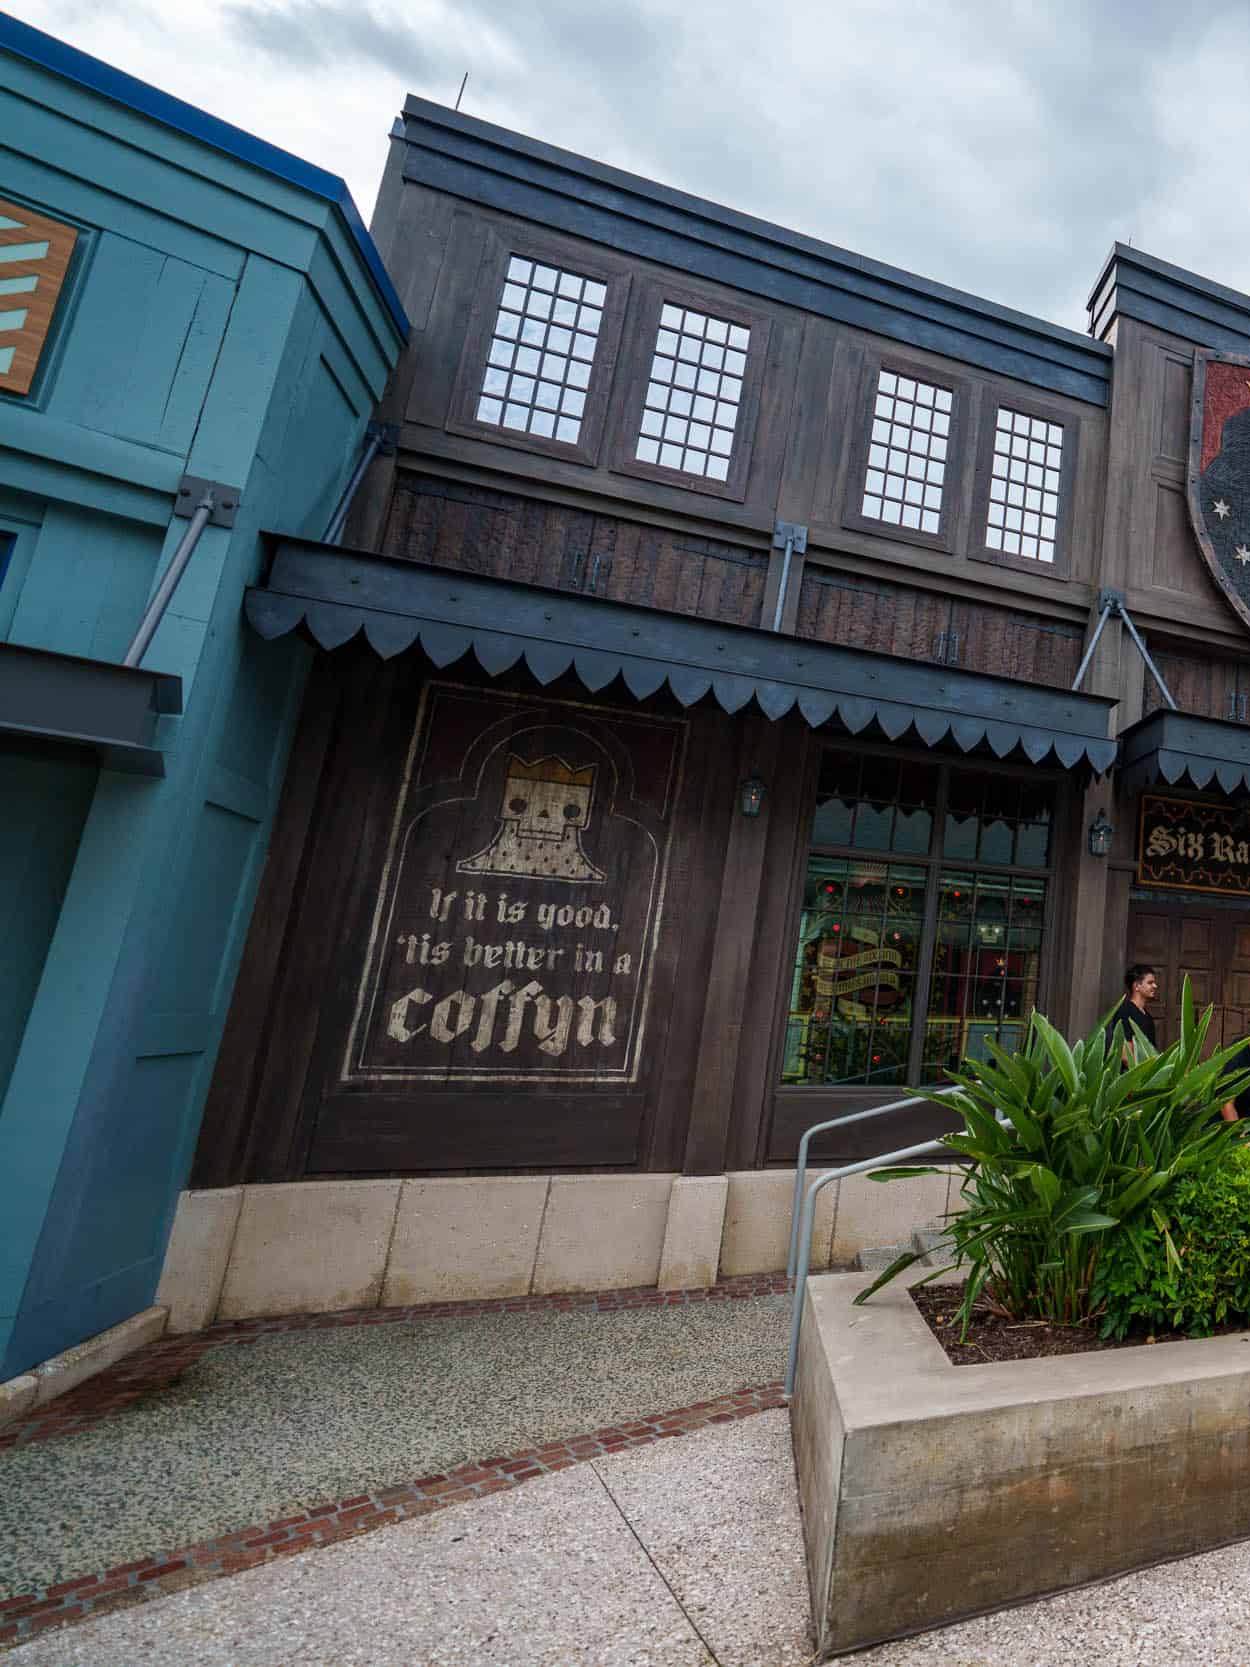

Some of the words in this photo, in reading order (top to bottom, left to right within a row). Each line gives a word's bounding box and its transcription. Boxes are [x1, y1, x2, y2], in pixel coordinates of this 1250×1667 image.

[1146, 825, 1205, 861] Six
[429, 887, 457, 922] If
[464, 890, 488, 920] it
[496, 893, 529, 924] is
[462, 936, 565, 970] better
[575, 942, 604, 974] in
[613, 952, 633, 976] a
[386, 979, 618, 1057] coffyn
